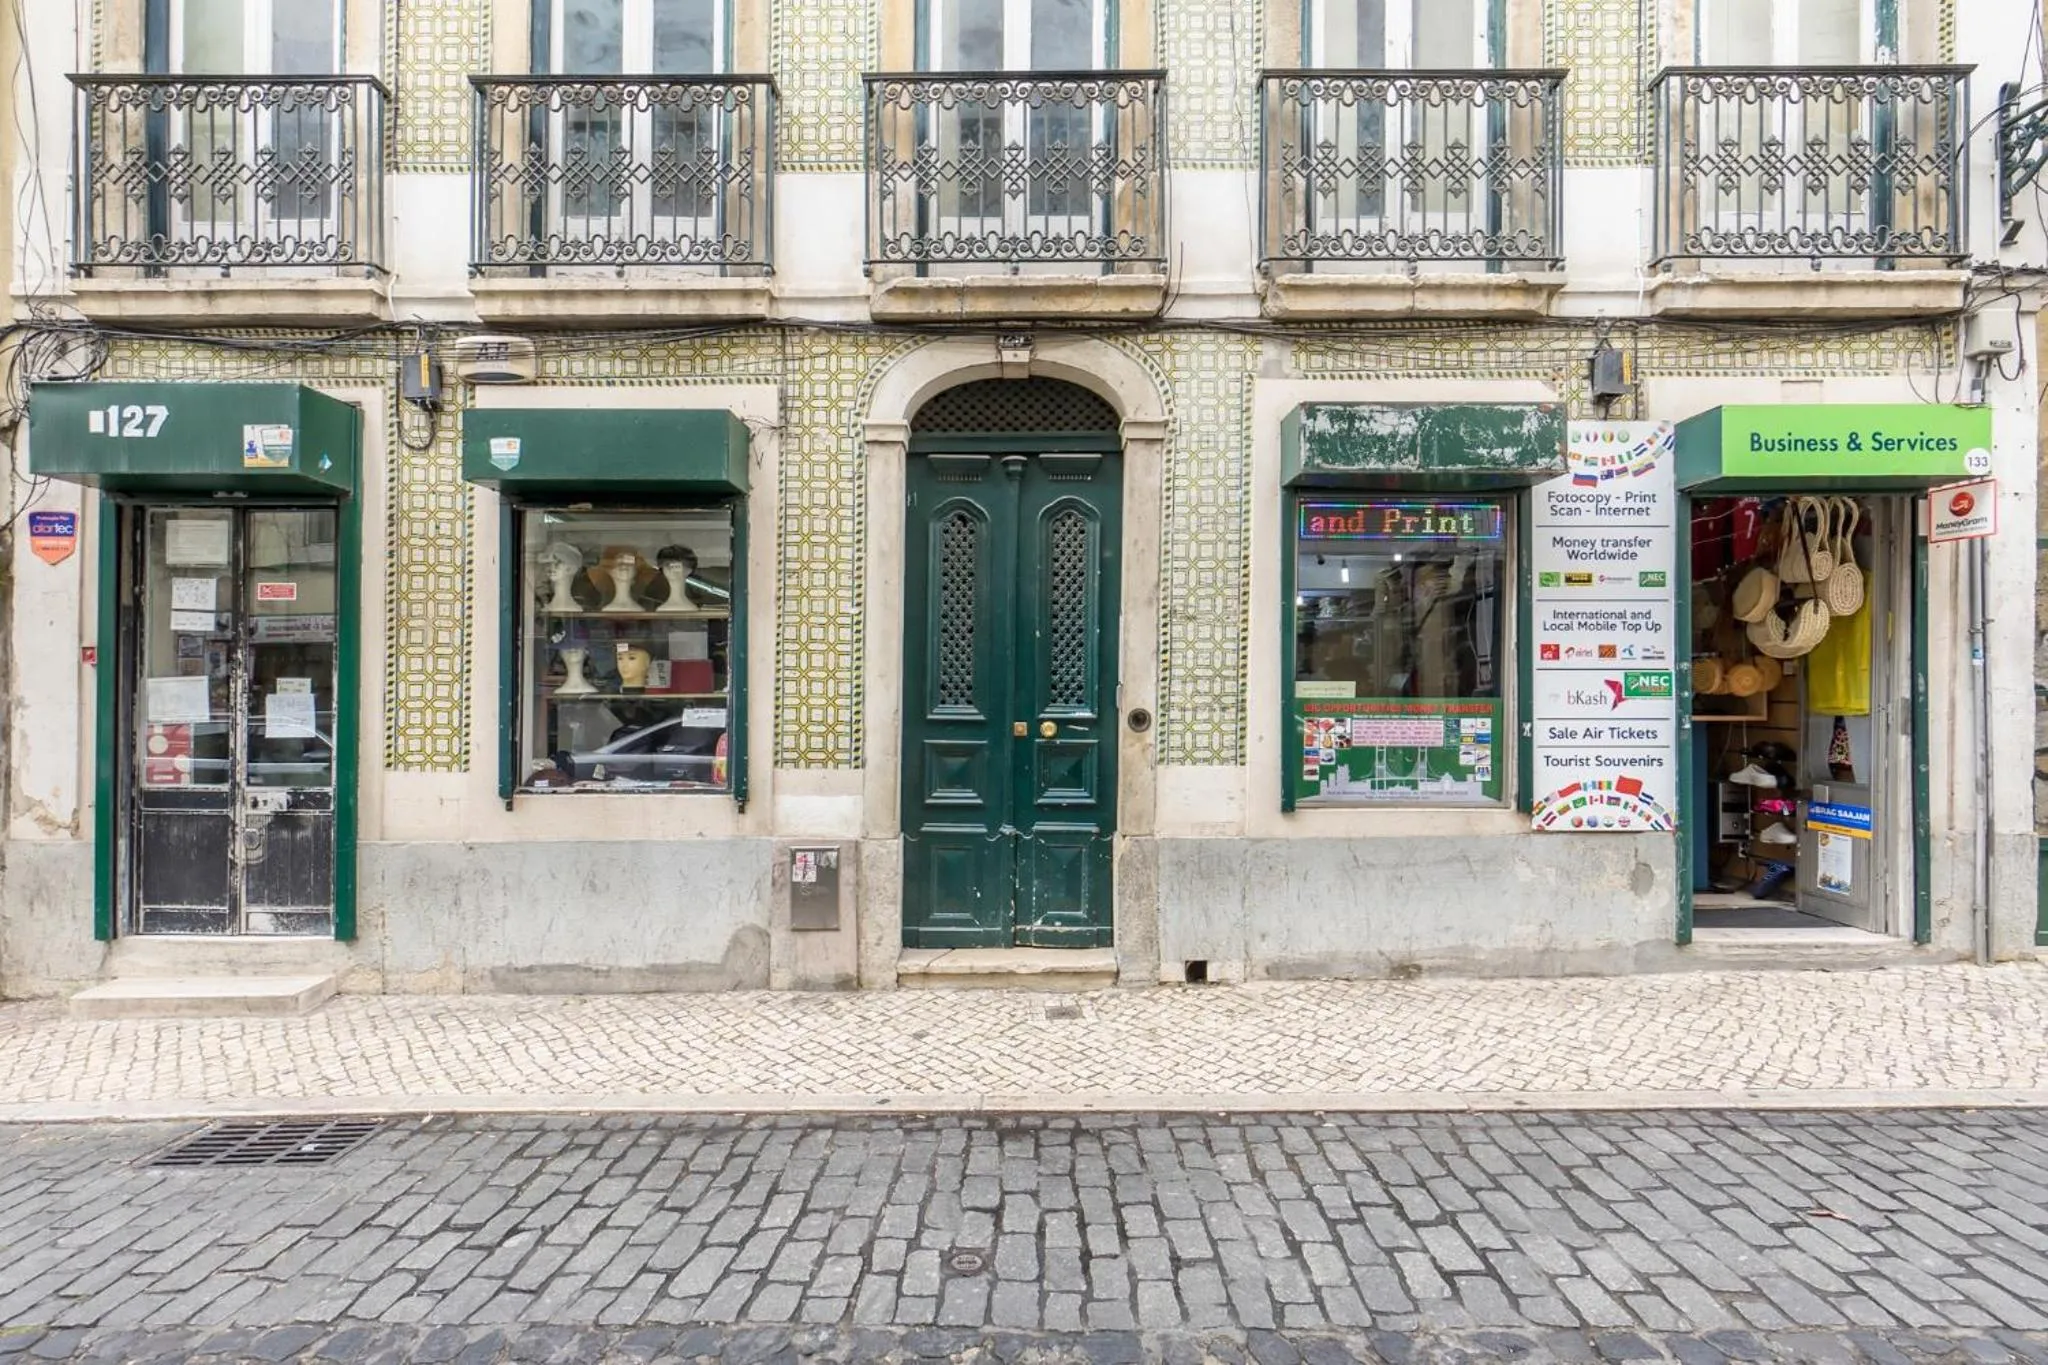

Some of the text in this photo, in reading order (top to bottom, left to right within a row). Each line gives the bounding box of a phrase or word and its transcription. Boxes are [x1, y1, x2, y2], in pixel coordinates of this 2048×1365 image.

[105, 405, 170, 438] 127
[1750, 432, 1958, 452] Business & Services
[1967, 456, 1989, 468] 133
[1547, 491, 1612, 505] Fotocopy
[1625, 491, 1657, 503] Print
[1550, 504, 1582, 516] Scan
[1595, 504, 1651, 516] Internet
[1310, 509, 1475, 533] and Print
[1552, 536, 1653, 550] Money transfer
[1566, 549, 1638, 561] Worldwide
[1553, 609, 1652, 620] International and
[1543, 621, 1663, 634] Local Mobile Top Up
[1640, 675, 1670, 687] NEC
[1567, 689, 1608, 705] bKash
[1548, 726, 1658, 740] Sale Air Tickets
[1543, 755, 1664, 767] Tourist Souvenirs
